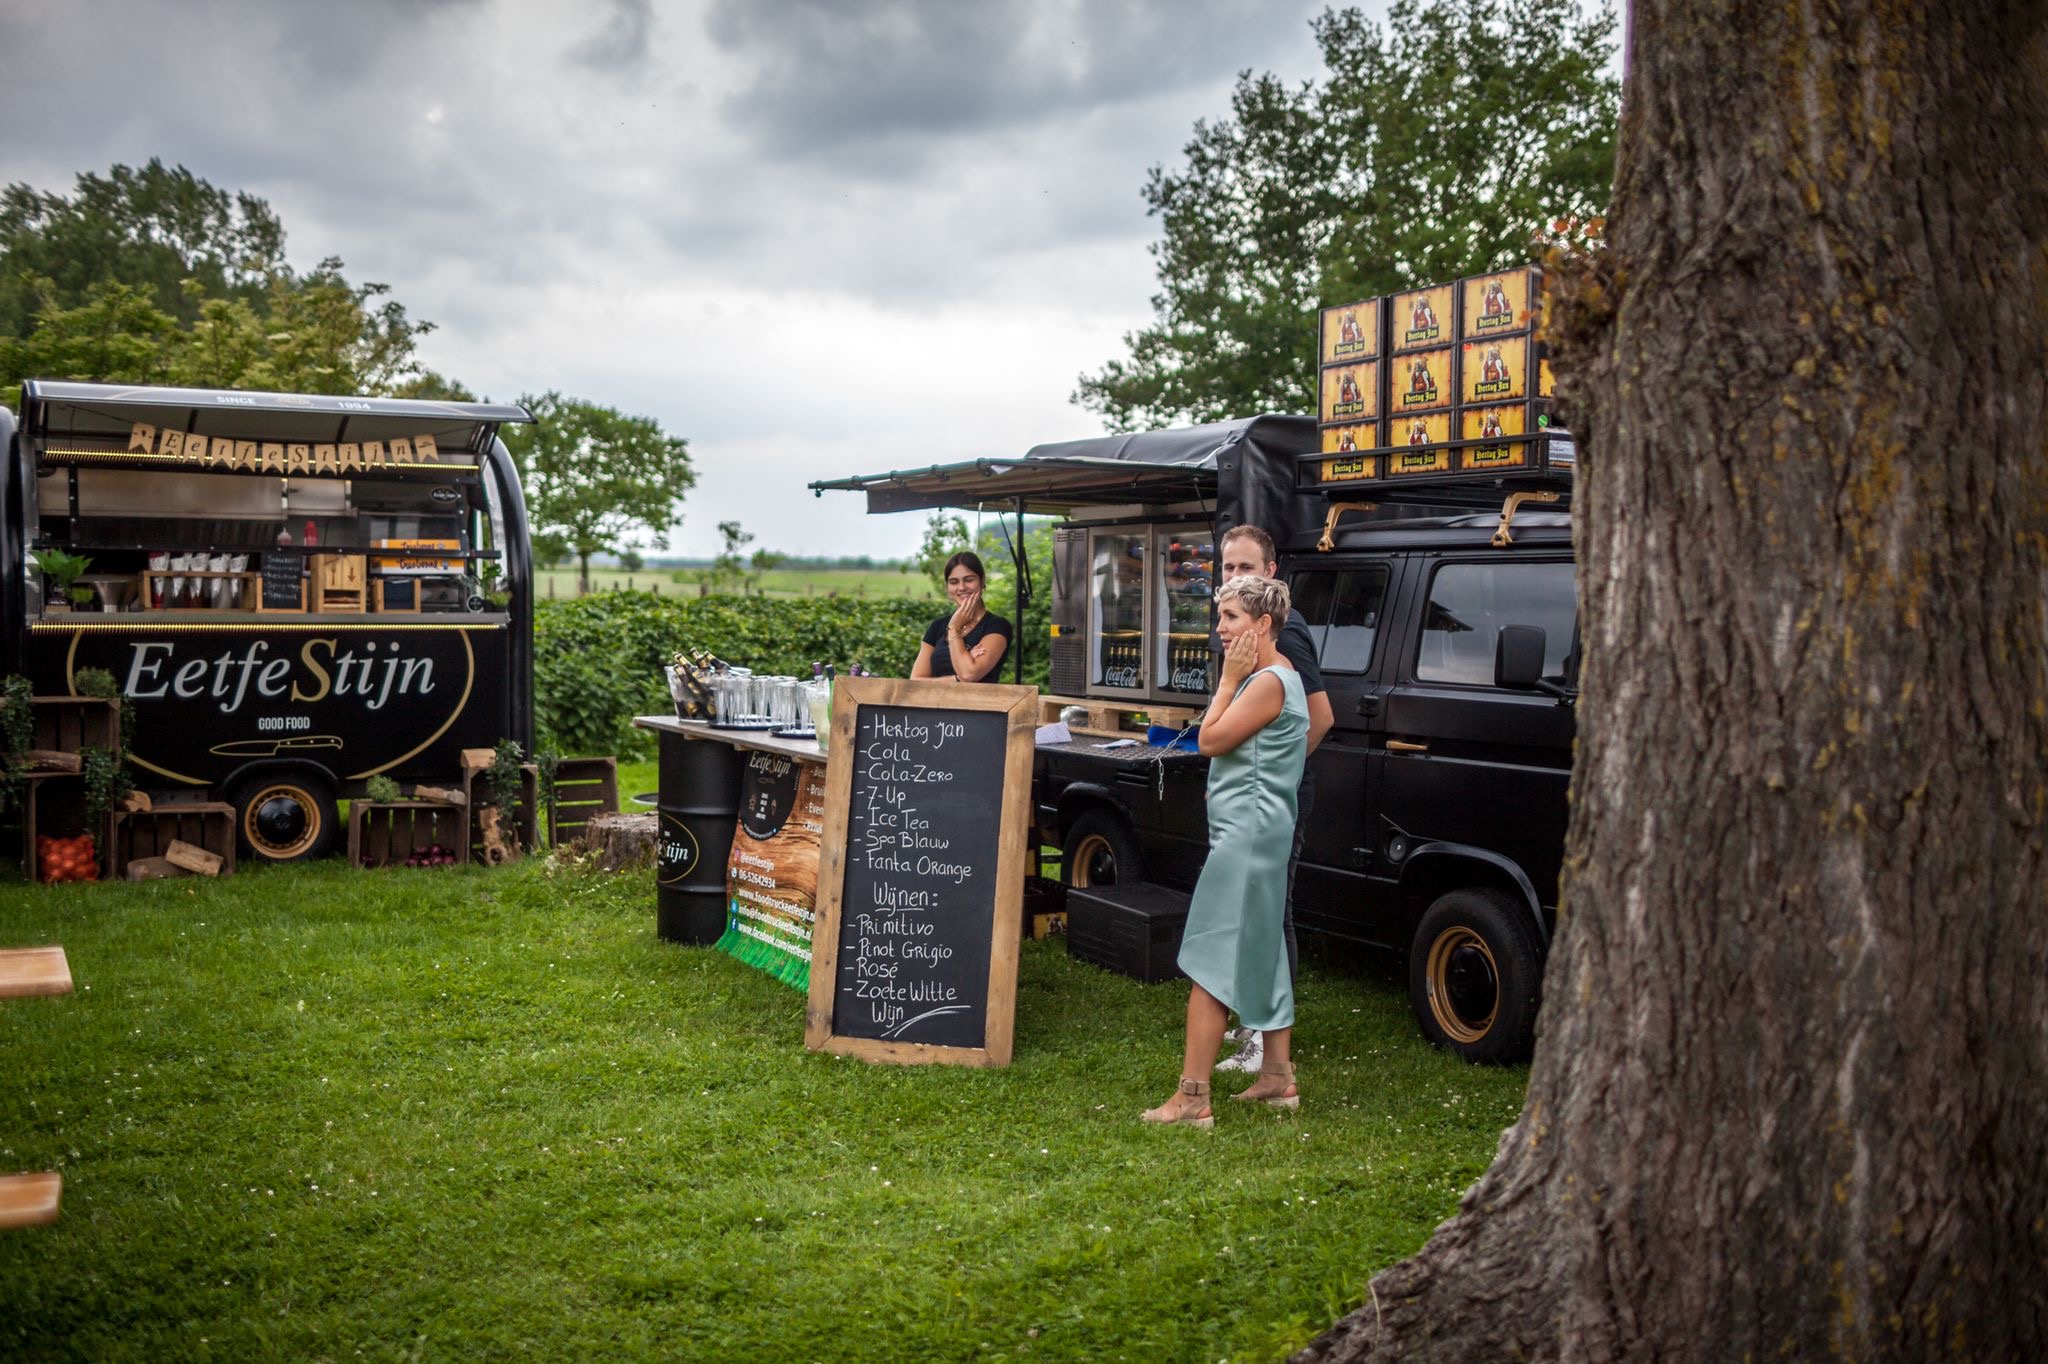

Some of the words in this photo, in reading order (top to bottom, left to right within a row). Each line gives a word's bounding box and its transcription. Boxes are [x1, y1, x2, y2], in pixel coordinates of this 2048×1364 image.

[216, 396, 256, 404] SINCE
[124, 638, 436, 712] EetfeStijn
[258, 717, 284, 730] GOOD
[286, 716, 310, 729] FOOD
[868, 742, 911, 761] Cola
[749, 751, 792, 778] EetfeStijn
[867, 785, 906, 810] 7-Up
[869, 806, 898, 827] Ice
[901, 808, 929, 830] Tea
[865, 829, 896, 849] Spa
[898, 831, 950, 849] Blauw
[740, 852, 775, 872] @eetfestijn
[865, 848, 912, 872] Fanta
[916, 856, 973, 884] Orange
[856, 913, 934, 936] Primitivo
[859, 937, 895, 958] Pinot
[901, 941, 953, 969] Grigio
[856, 957, 899, 978] Rosé
[856, 980, 907, 1001] Zoete
[909, 979, 958, 1002] Witte
[871, 1001, 904, 1028] Wijn
